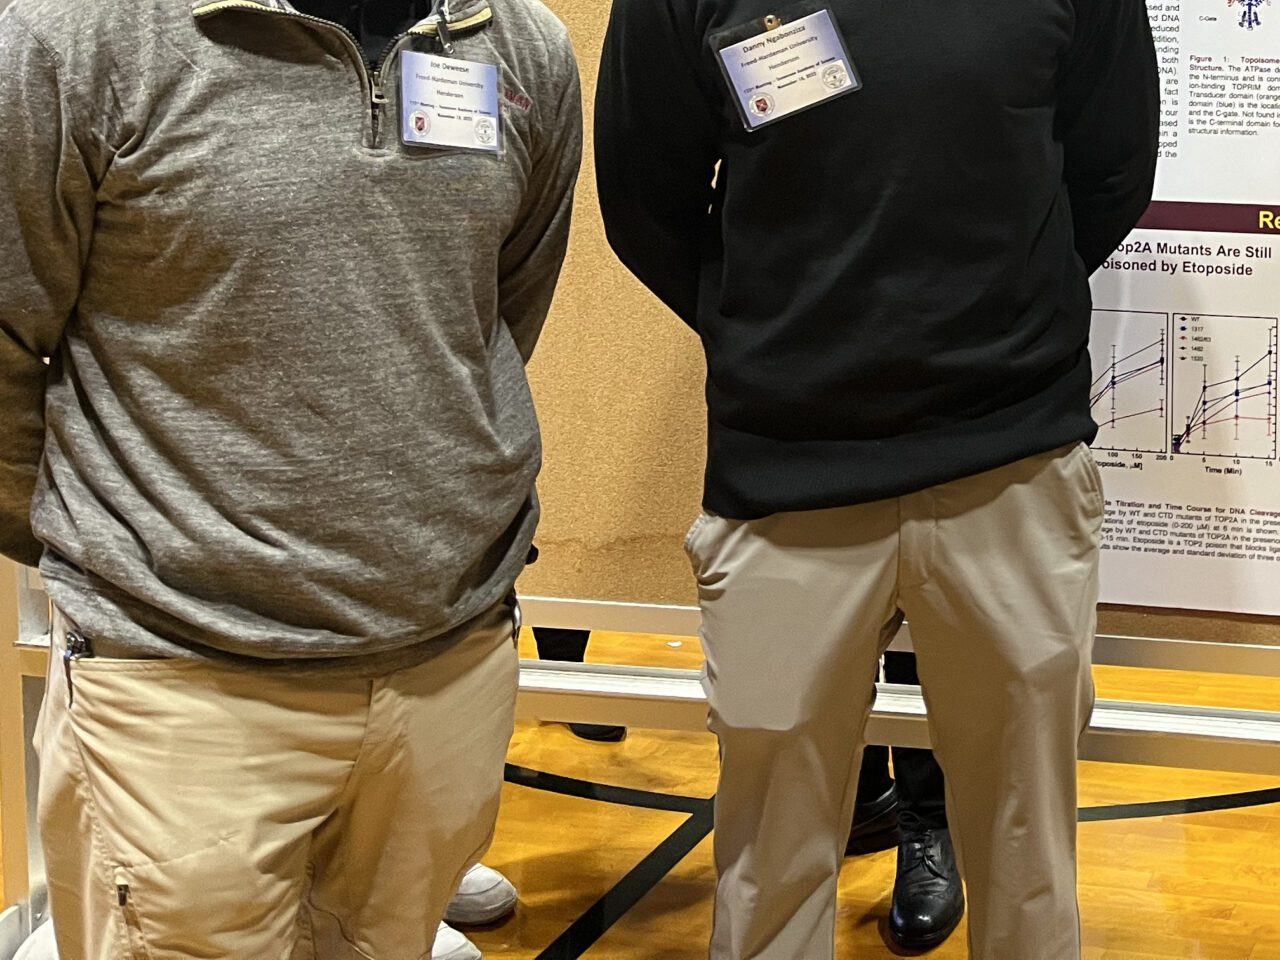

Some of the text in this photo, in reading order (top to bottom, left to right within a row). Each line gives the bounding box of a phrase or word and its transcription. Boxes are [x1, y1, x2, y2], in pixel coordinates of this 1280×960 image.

[742, 40, 765, 54] Danny
[1116, 241, 1271, 258] op2A Mutants Are Still
[1102, 258, 1252, 276] oisoned by Etoposide
